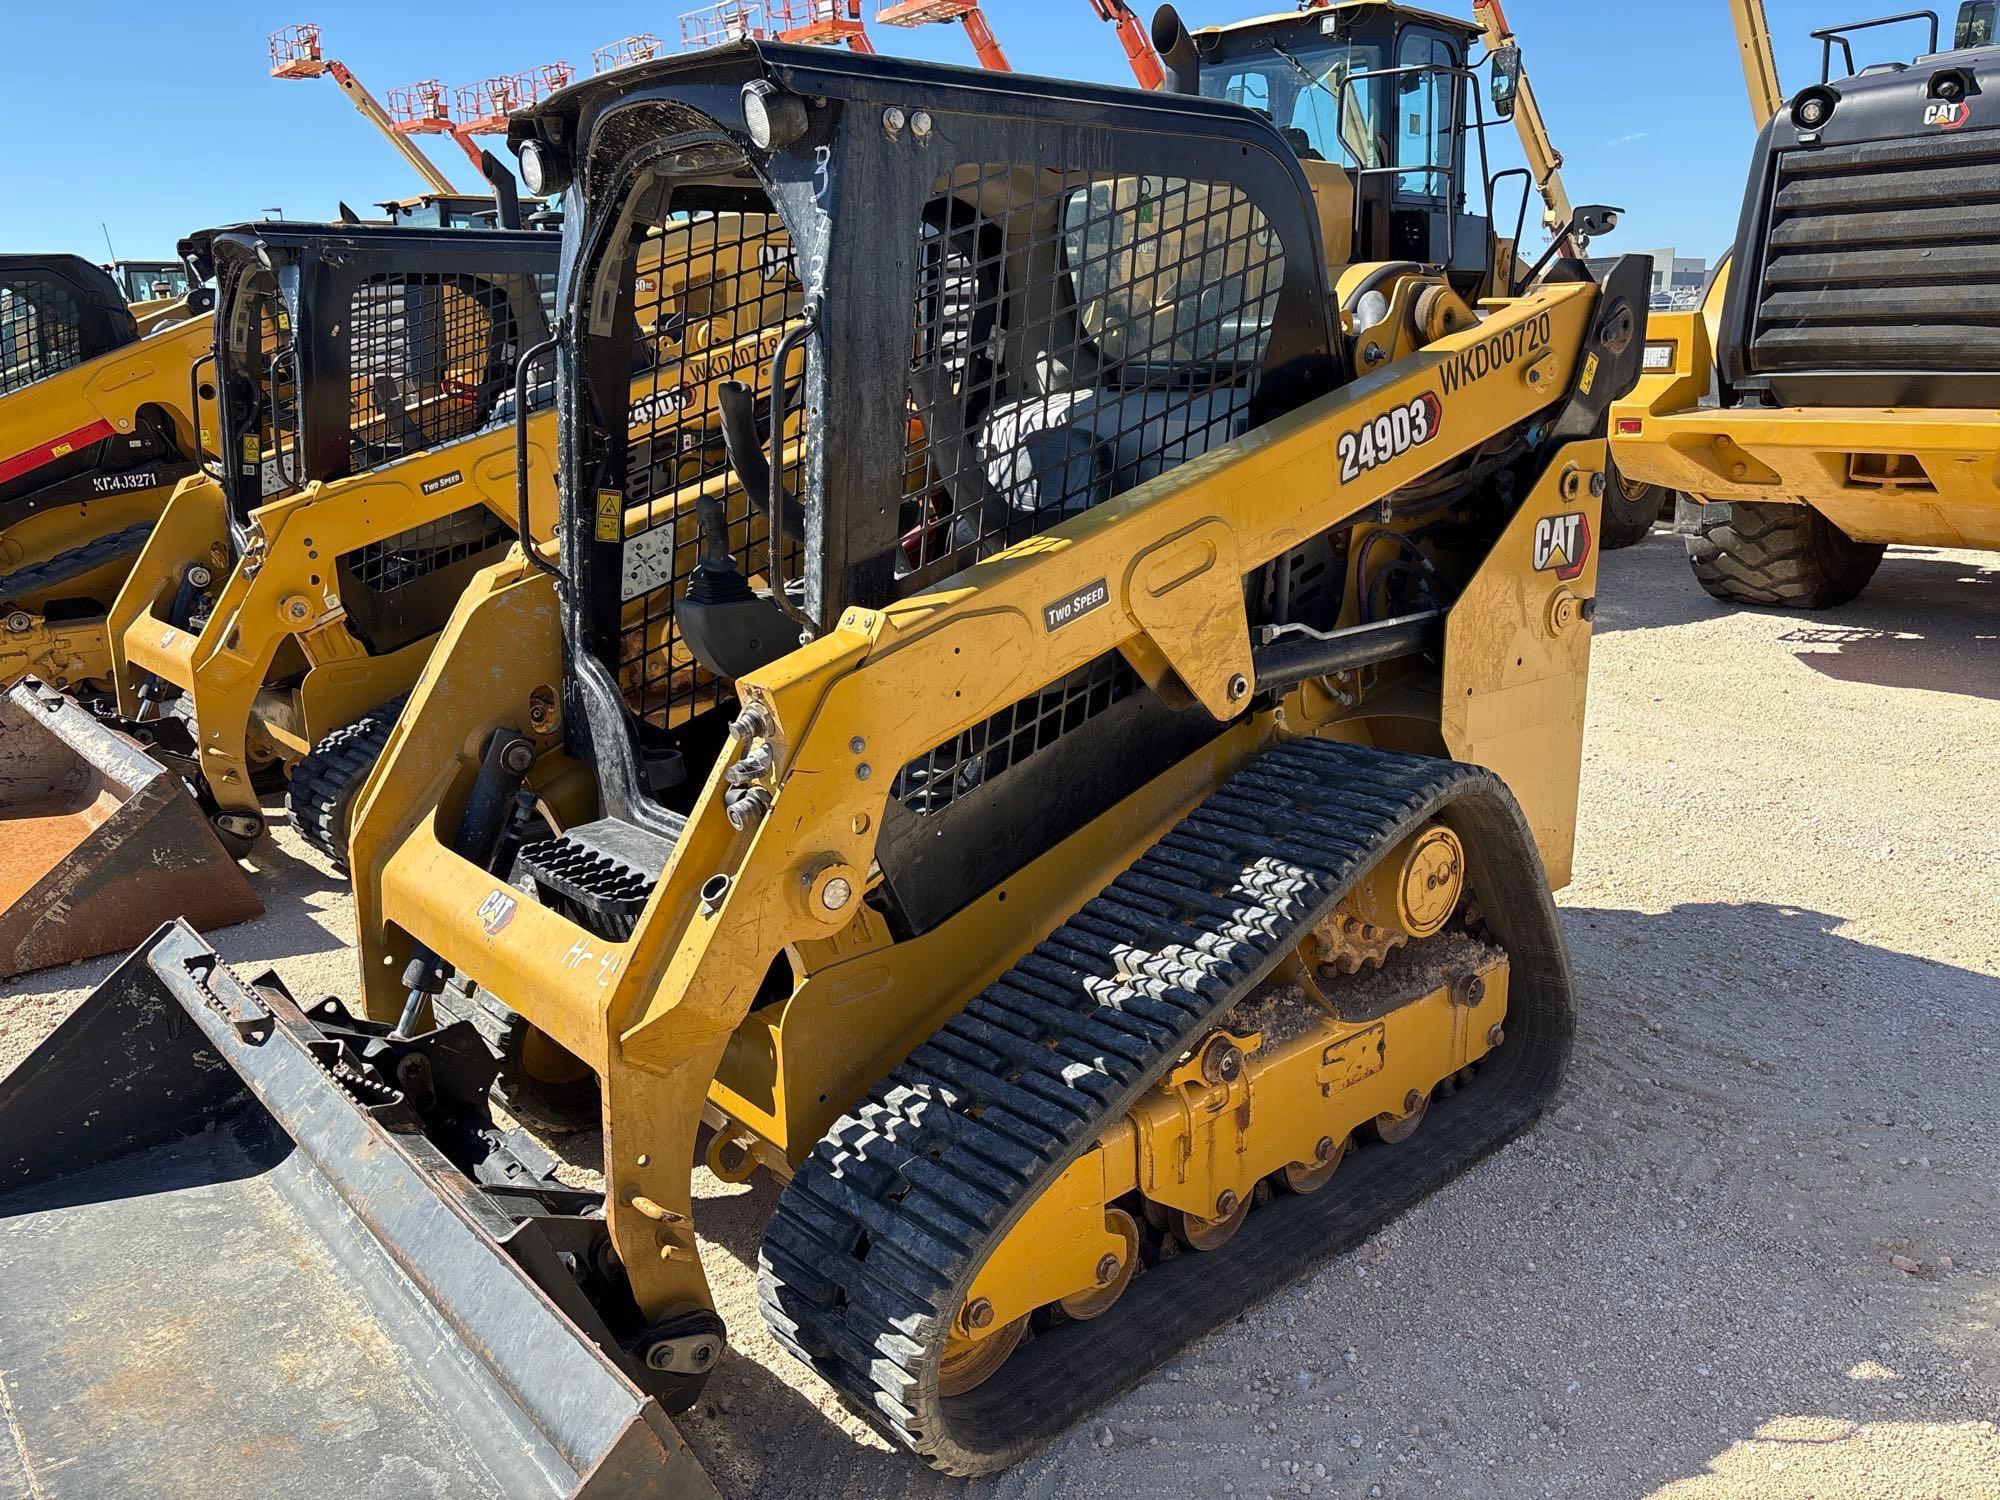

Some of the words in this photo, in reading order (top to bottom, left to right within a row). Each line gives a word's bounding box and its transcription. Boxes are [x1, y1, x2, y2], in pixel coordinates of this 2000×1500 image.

[1923, 103, 1960, 125] CAT
[1438, 311, 1551, 396] WKD00720
[1338, 398, 1428, 482] 249D3
[1533, 514, 1580, 570] CAT
[478, 889, 515, 926] CAT
